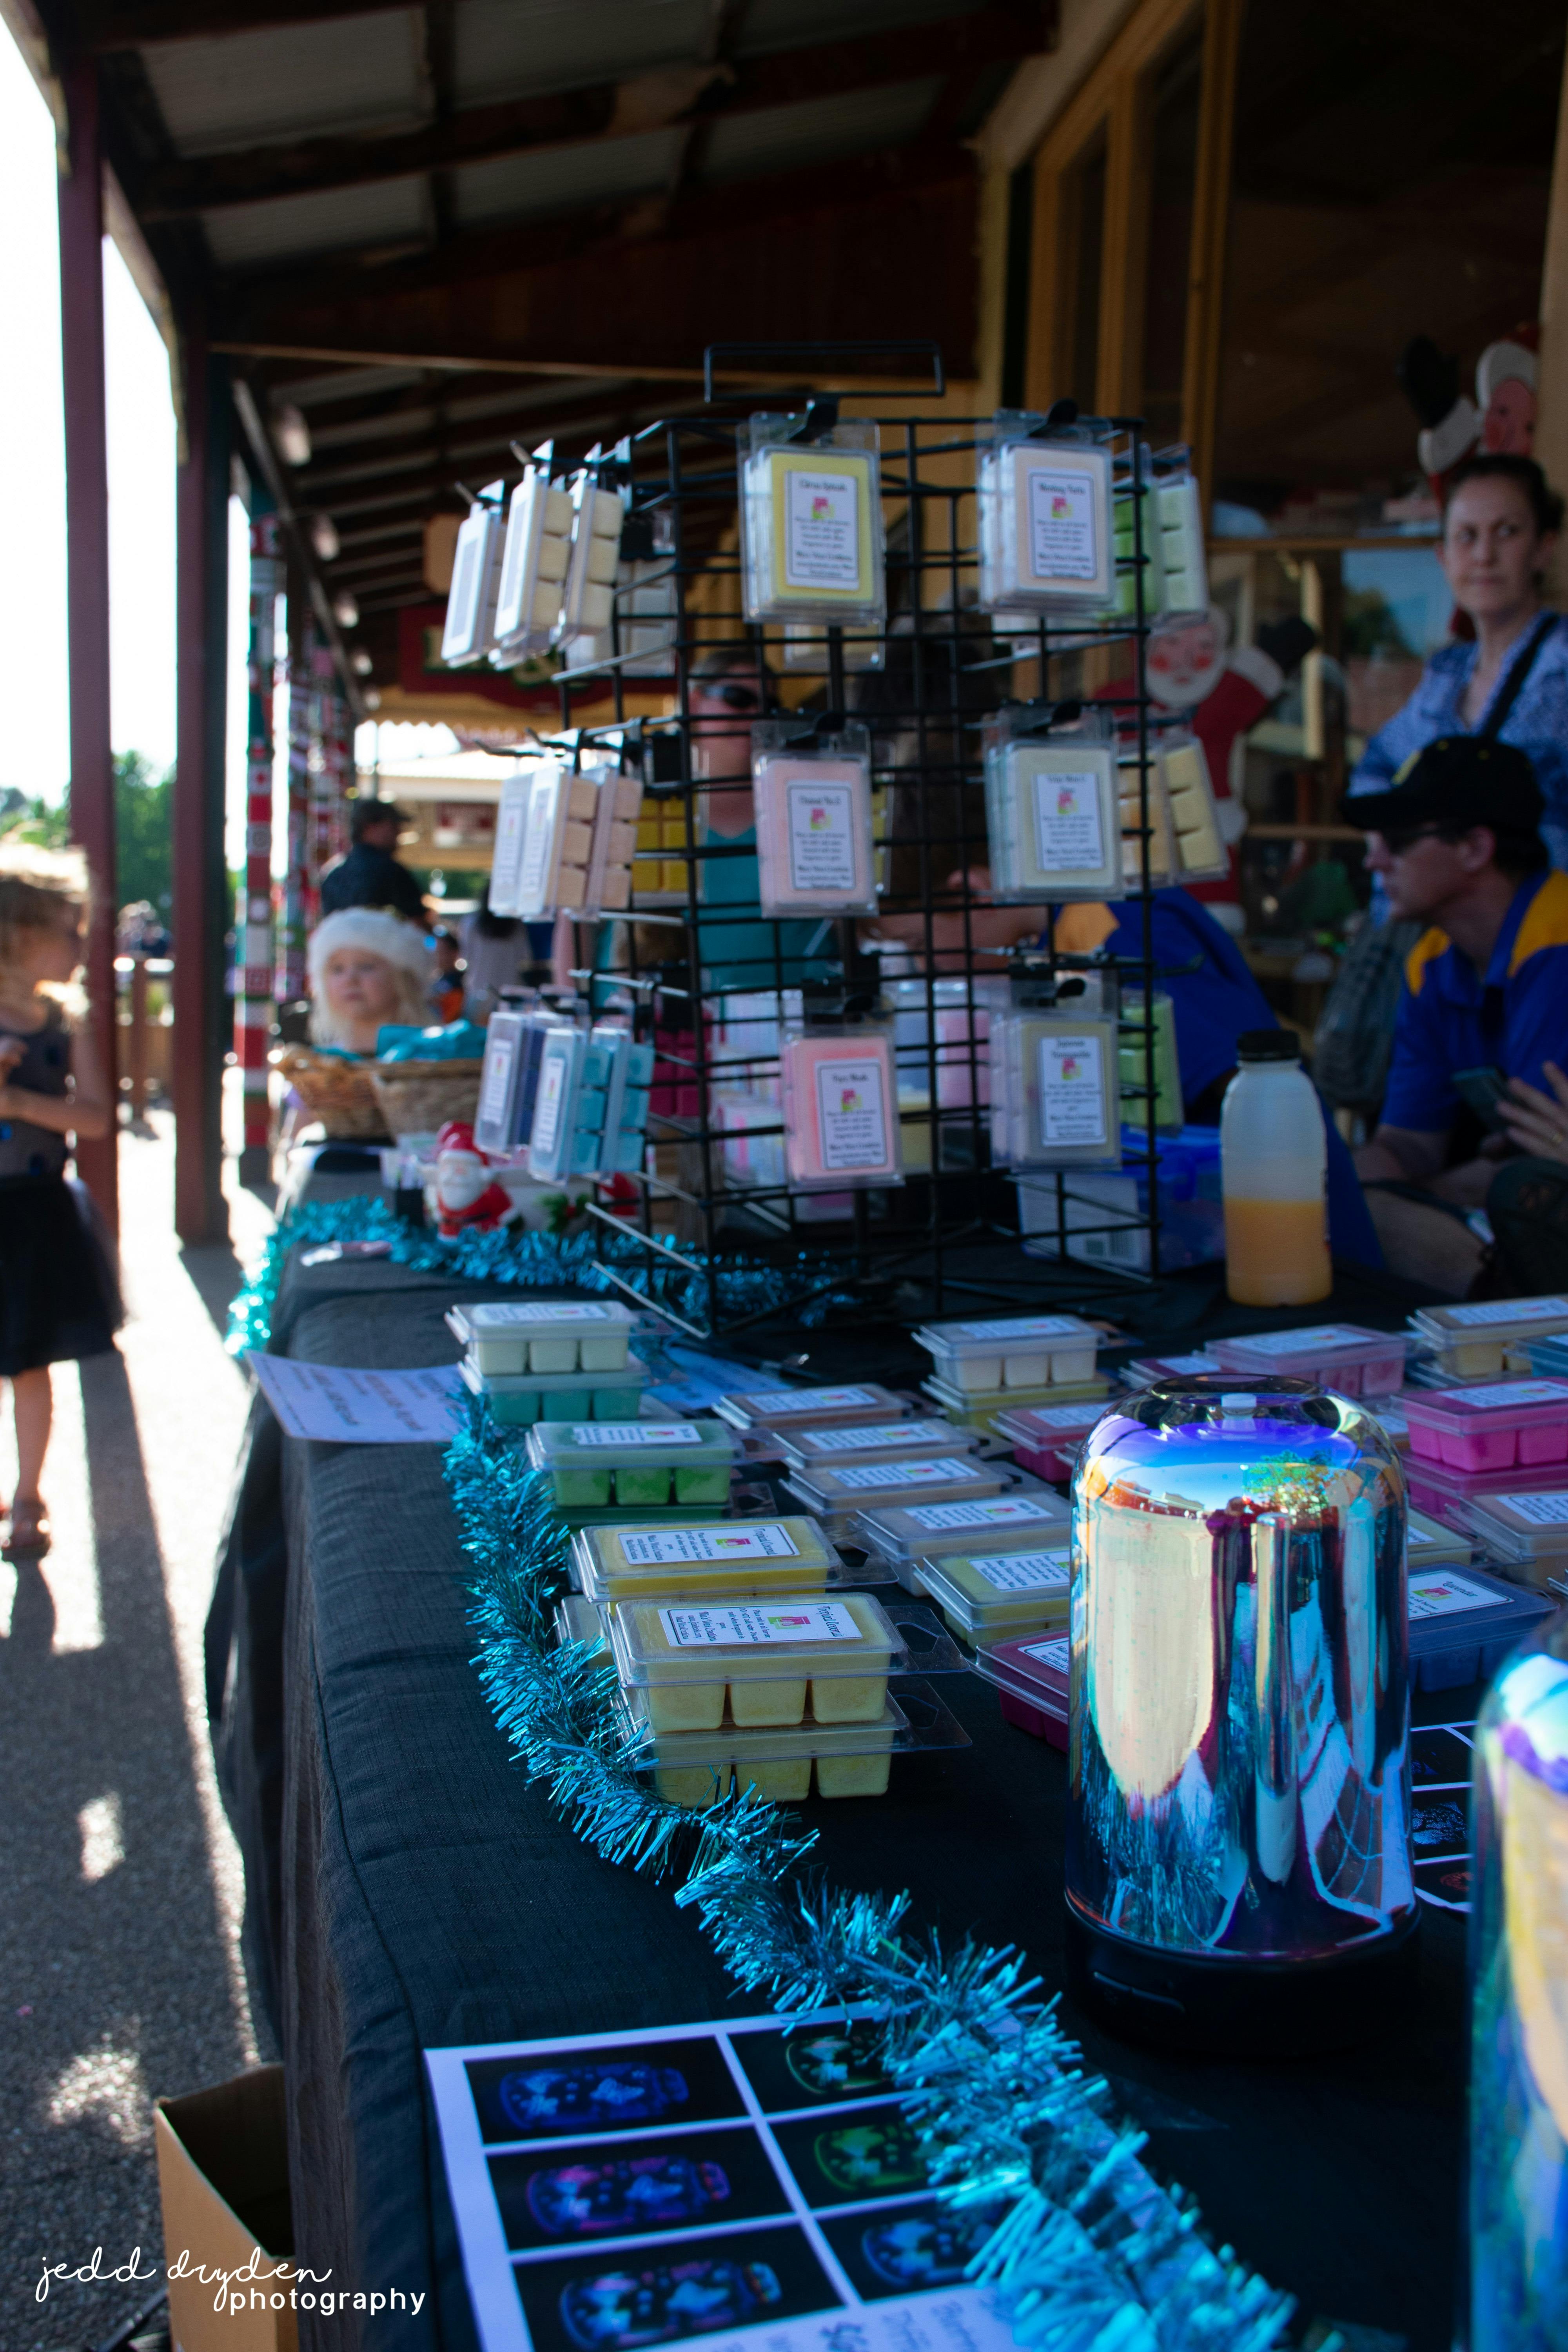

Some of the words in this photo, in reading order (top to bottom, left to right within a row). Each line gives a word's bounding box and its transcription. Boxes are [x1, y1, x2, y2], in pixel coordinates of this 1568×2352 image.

[761, 1542, 777, 1555] Coconut
[1443, 1581, 1479, 1597] Lavender
[816, 1606, 837, 1622] Tropical
[702, 1619, 713, 1628] Wax
[731, 1624, 743, 1635] fragrance
[826, 1621, 844, 1637] Coconut
[705, 1628, 717, 1641] Creations
[750, 1632, 761, 1641] Discard
